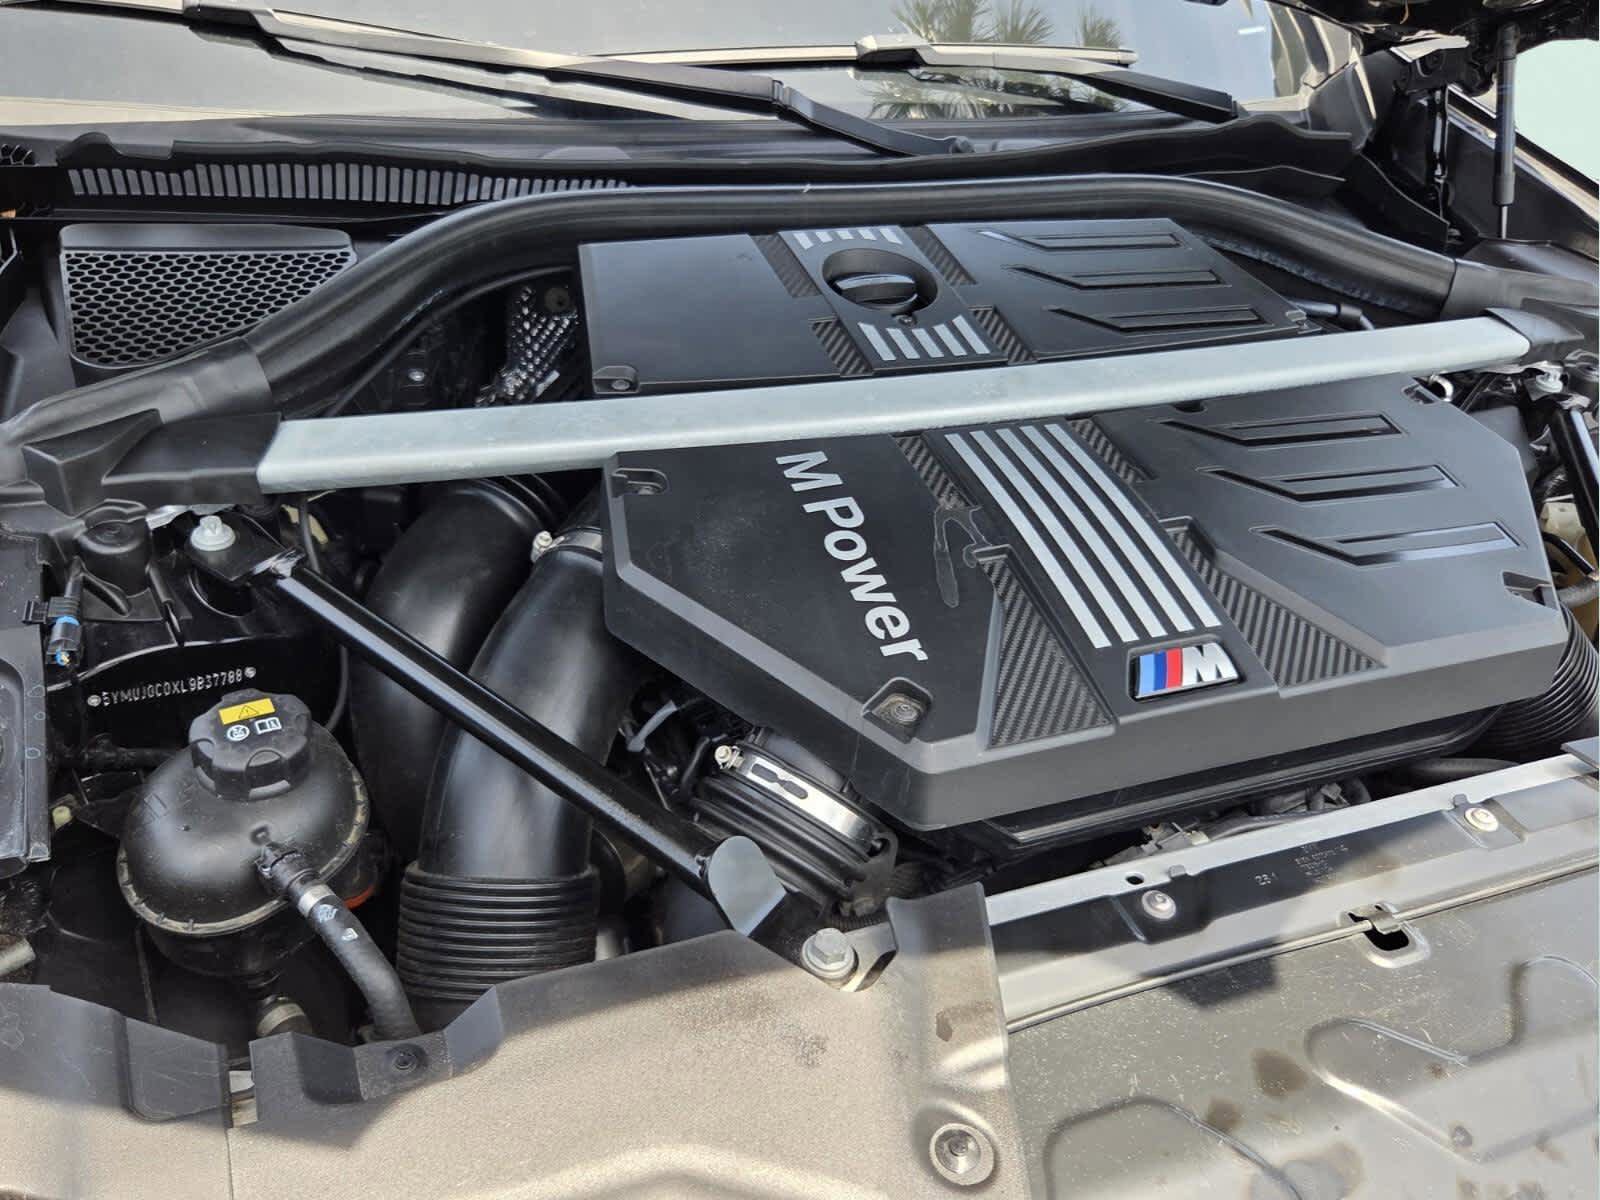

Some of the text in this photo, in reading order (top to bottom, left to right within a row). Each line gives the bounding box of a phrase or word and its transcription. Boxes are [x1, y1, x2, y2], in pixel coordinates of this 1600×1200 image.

[775, 450, 929, 661] M Power
[1181, 641, 1239, 687] M
